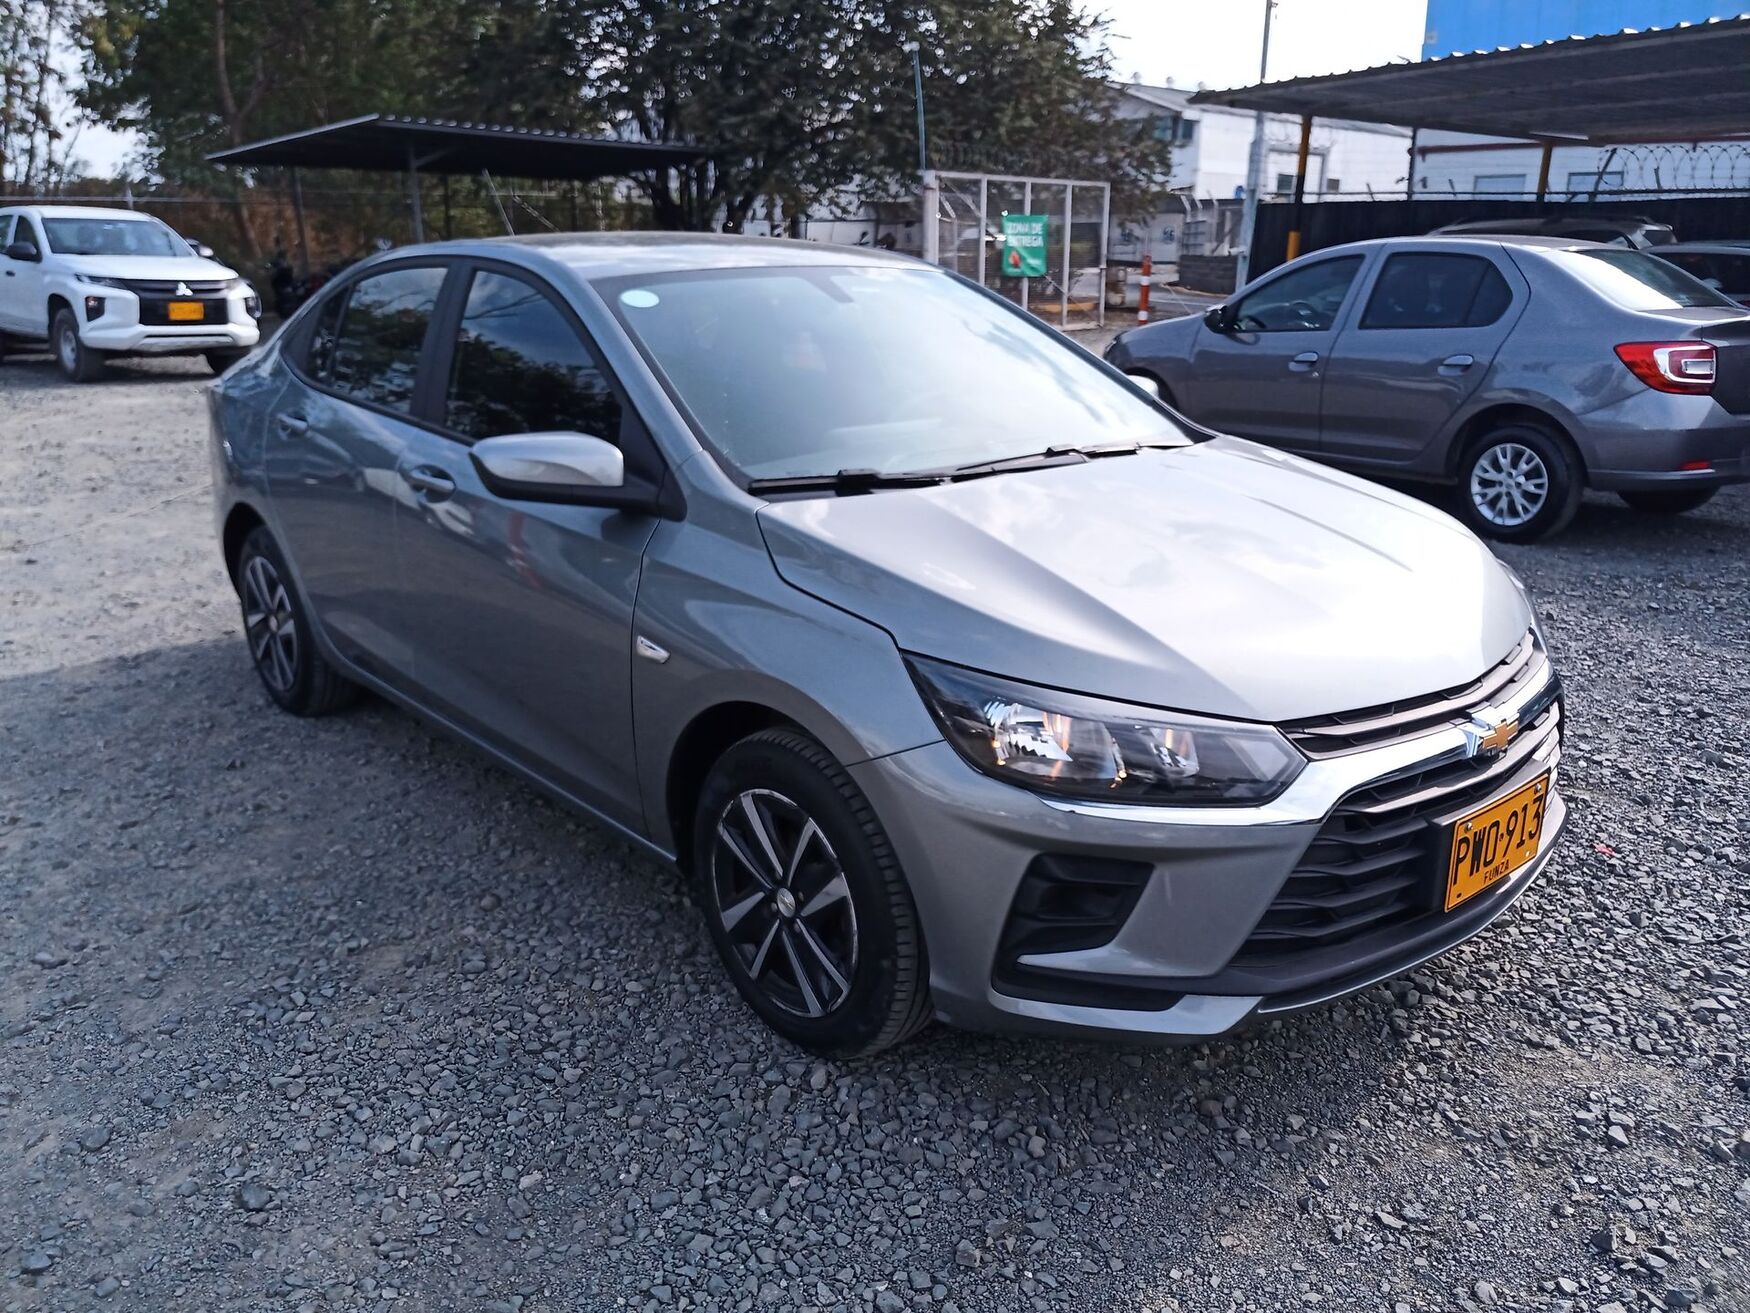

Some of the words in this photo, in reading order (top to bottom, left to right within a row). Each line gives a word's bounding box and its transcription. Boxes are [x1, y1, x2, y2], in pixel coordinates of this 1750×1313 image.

[1006, 222, 1029, 235] ZONA
[1031, 223, 1043, 235] DE
[1006, 235, 1044, 247] ENTREGA
[1483, 859, 1510, 884] FUNZA
